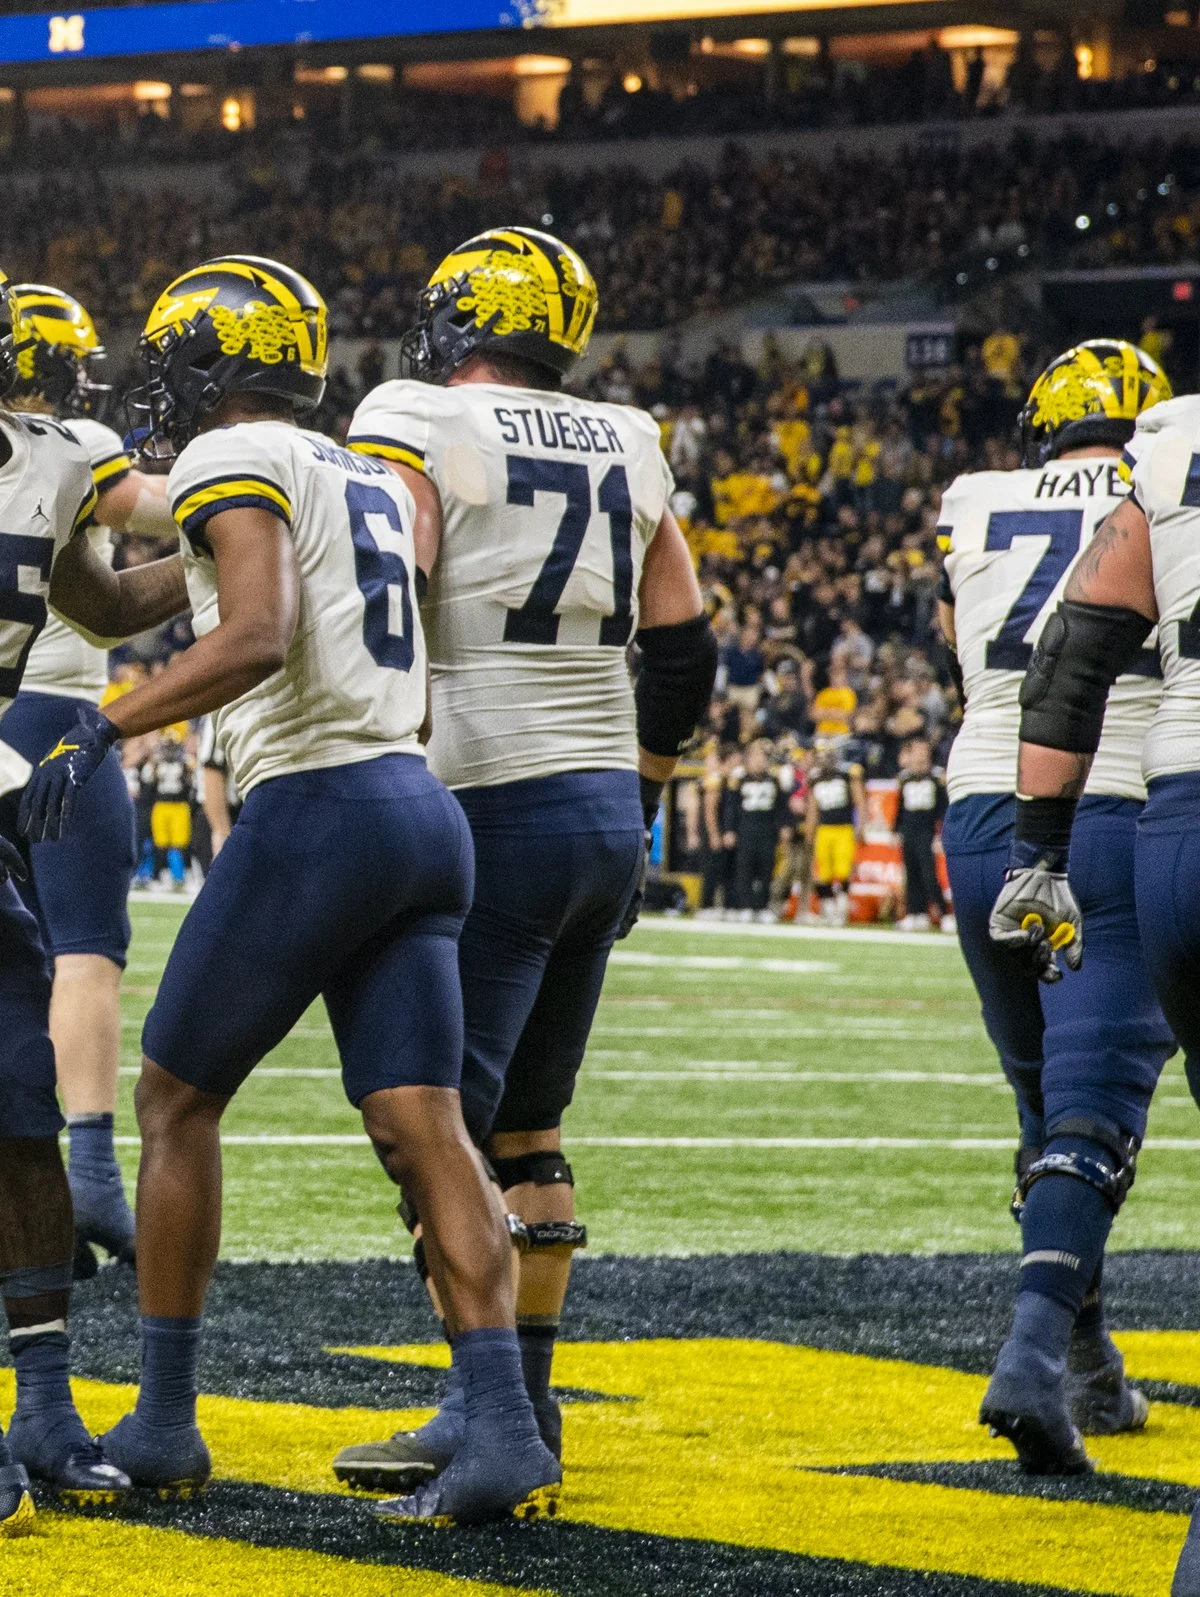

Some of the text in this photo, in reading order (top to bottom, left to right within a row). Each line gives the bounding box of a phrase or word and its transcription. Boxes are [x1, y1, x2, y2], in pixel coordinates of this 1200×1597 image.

[48, 15, 85, 52] M
[493, 407, 625, 454] STUEBER
[1035, 463, 1126, 499] HAYE
[503, 454, 634, 647] 71
[343, 478, 414, 674] 6
